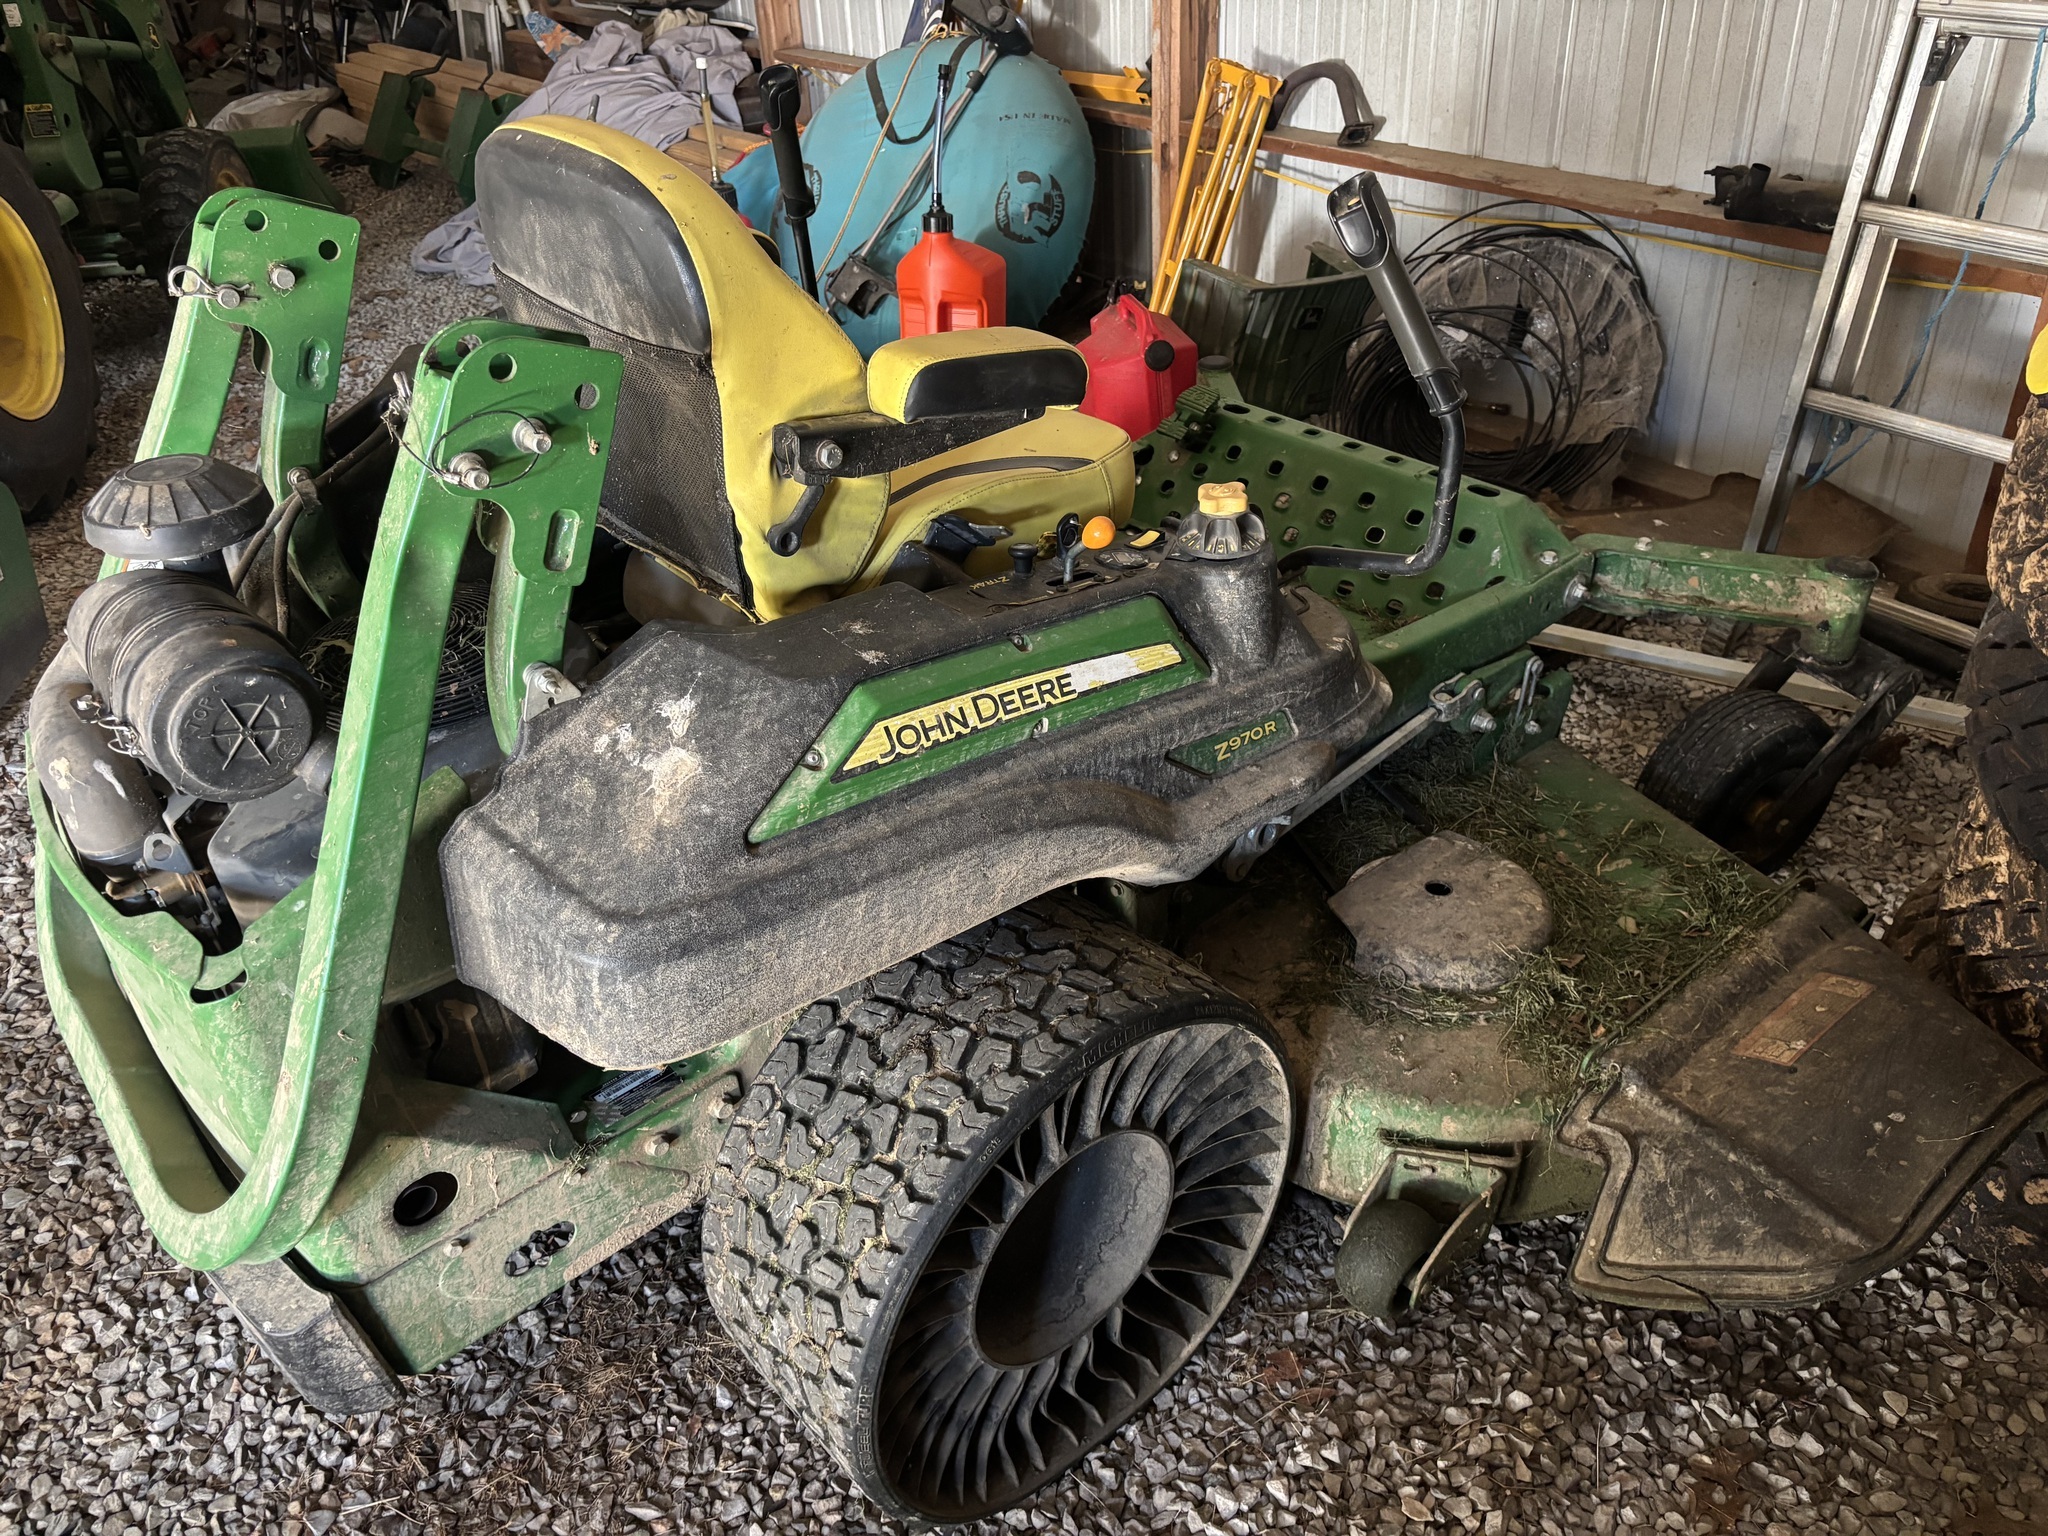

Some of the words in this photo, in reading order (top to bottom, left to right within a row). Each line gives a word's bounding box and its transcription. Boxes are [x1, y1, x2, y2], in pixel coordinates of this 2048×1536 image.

[1050, 188, 1063, 227] STUFF
[969, 575, 1010, 590] ZTRAK
[184, 697, 214, 734] TOP
[878, 705, 971, 760] JOHN
[970, 673, 1078, 724] DEERE
[1213, 720, 1278, 762] Z970R
[1081, 1016, 1158, 1068] MICHELIN
[857, 1384, 875, 1426] TURF
